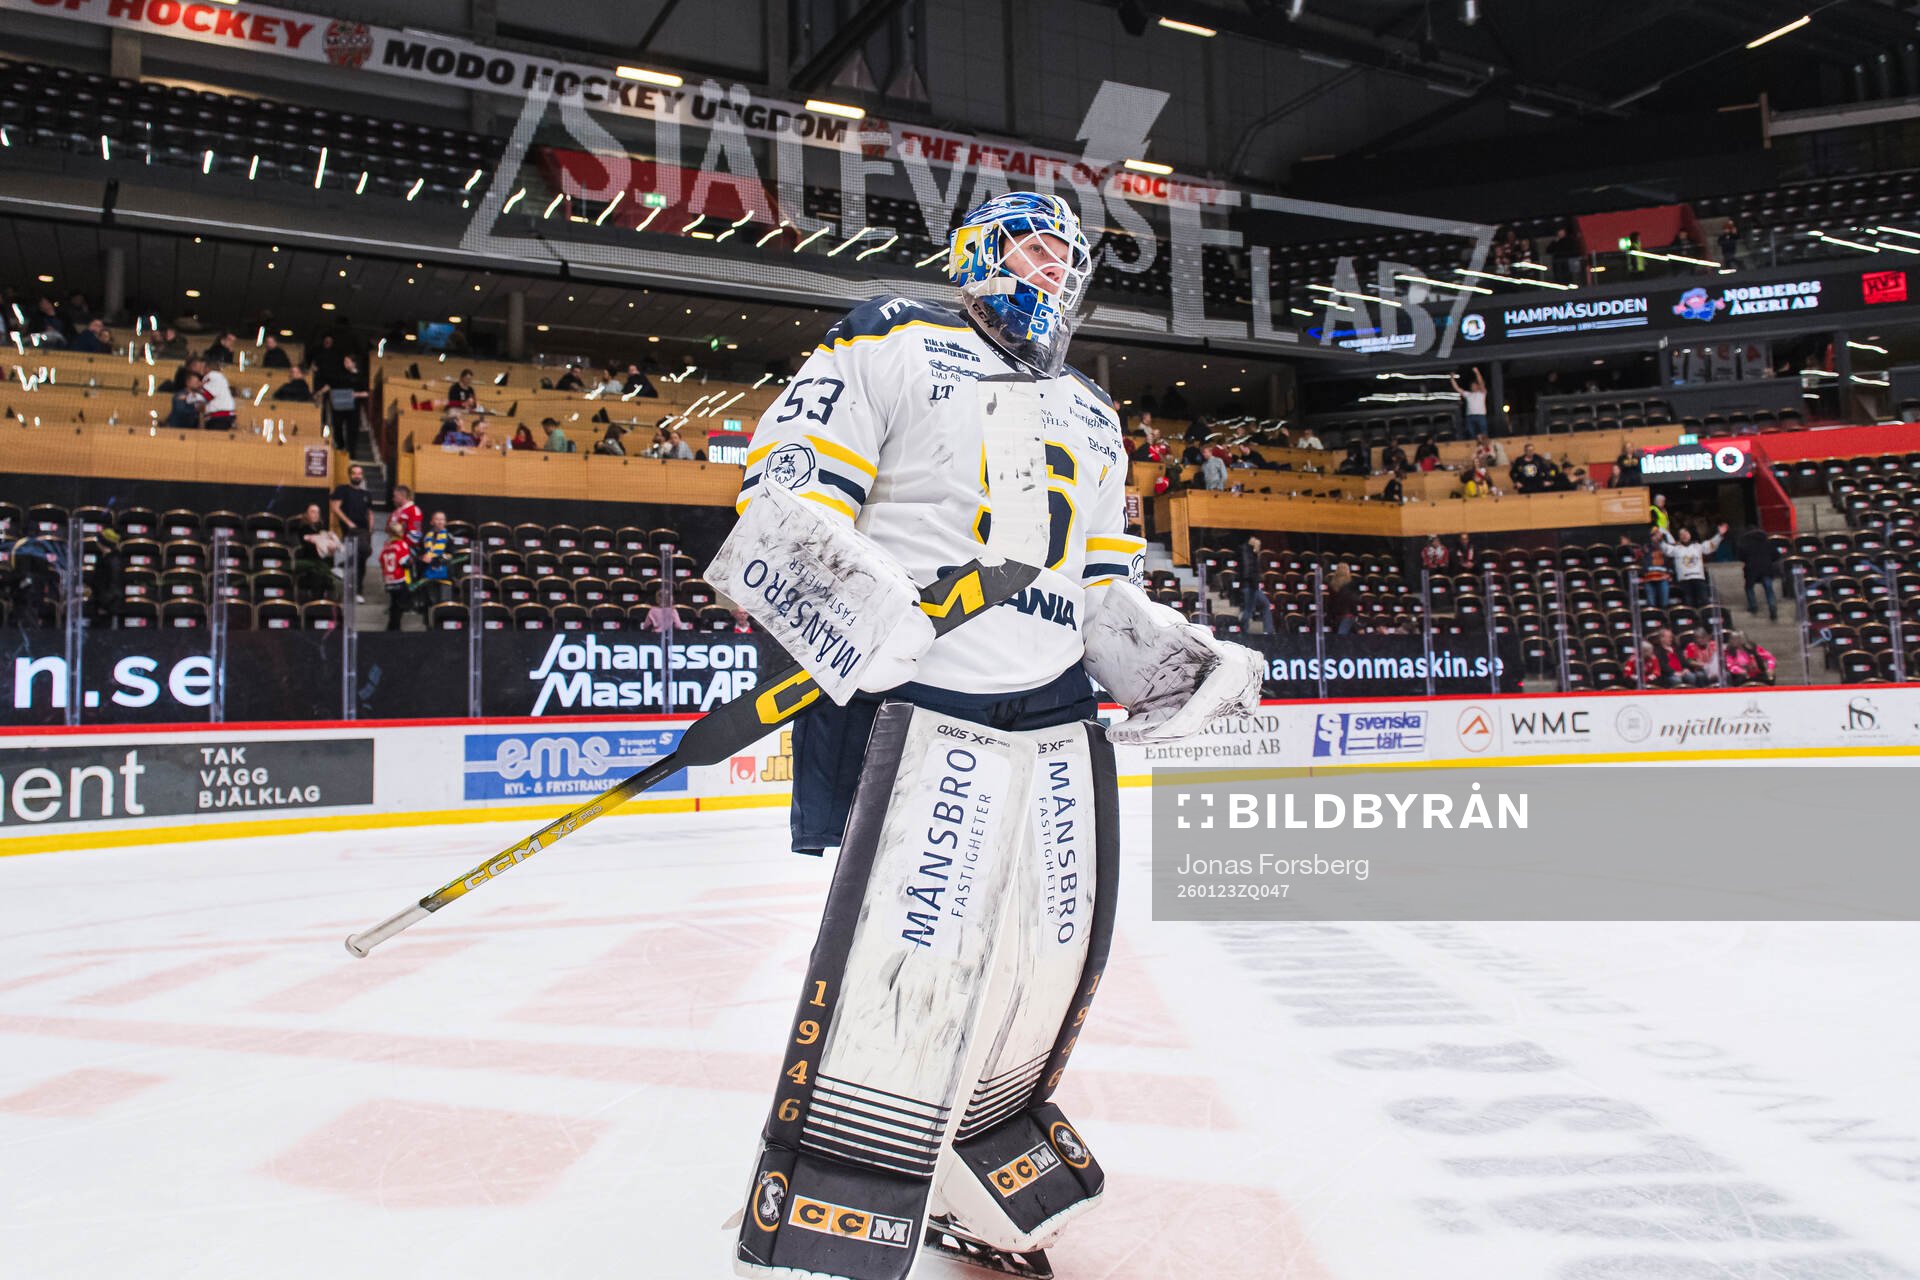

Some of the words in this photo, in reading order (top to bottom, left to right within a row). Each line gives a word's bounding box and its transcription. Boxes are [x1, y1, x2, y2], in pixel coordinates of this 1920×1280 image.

[107, 0, 314, 49] HOCKEY
[383, 39, 515, 85] MODO
[523, 63, 685, 115] HOCKEY
[691, 95, 849, 143] UNGDOM
[901, 125, 961, 162] THE
[968, 142, 1069, 182] HEART
[1114, 169, 1223, 206] HOCKEY
[1503, 298, 1648, 325] HAMPNÄSUDDEN
[1723, 280, 1823, 302] NORBERGS
[1729, 297, 1790, 316] ÅKERI
[1791, 295, 1819, 310] AB
[776, 377, 845, 426] 53
[929, 384, 954, 401] LT
[743, 559, 862, 679] MÅNSBRO
[529, 633, 758, 680] Johansson
[530, 670, 702, 717] Maskin
[970, 732, 998, 747] XF
[1355, 713, 1421, 730] svenska
[1376, 731, 1403, 750] tält
[1511, 711, 1591, 735] WMC
[201, 747, 247, 766] TAK
[496, 735, 612, 780] ems
[1048, 738, 1066, 753] XF
[1144, 740, 1252, 762] Entreprenad
[1256, 738, 1281, 755] AB
[0, 750, 146, 824] ent
[199, 785, 321, 809] BJÄLKLAG
[534, 781, 543, 793] &
[463, 837, 544, 891] CCM
[550, 818, 579, 840] XF
[901, 748, 978, 949] MÅNSBRO
[951, 791, 993, 919] FASTIGHETER
[1038, 796, 1055, 919] FASTIGHETER
[1047, 761, 1077, 946] MÅNSBRO
[777, 979, 828, 1124] 1946
[996, 1145, 1059, 1190] CCM
[798, 1202, 909, 1243] CCM
